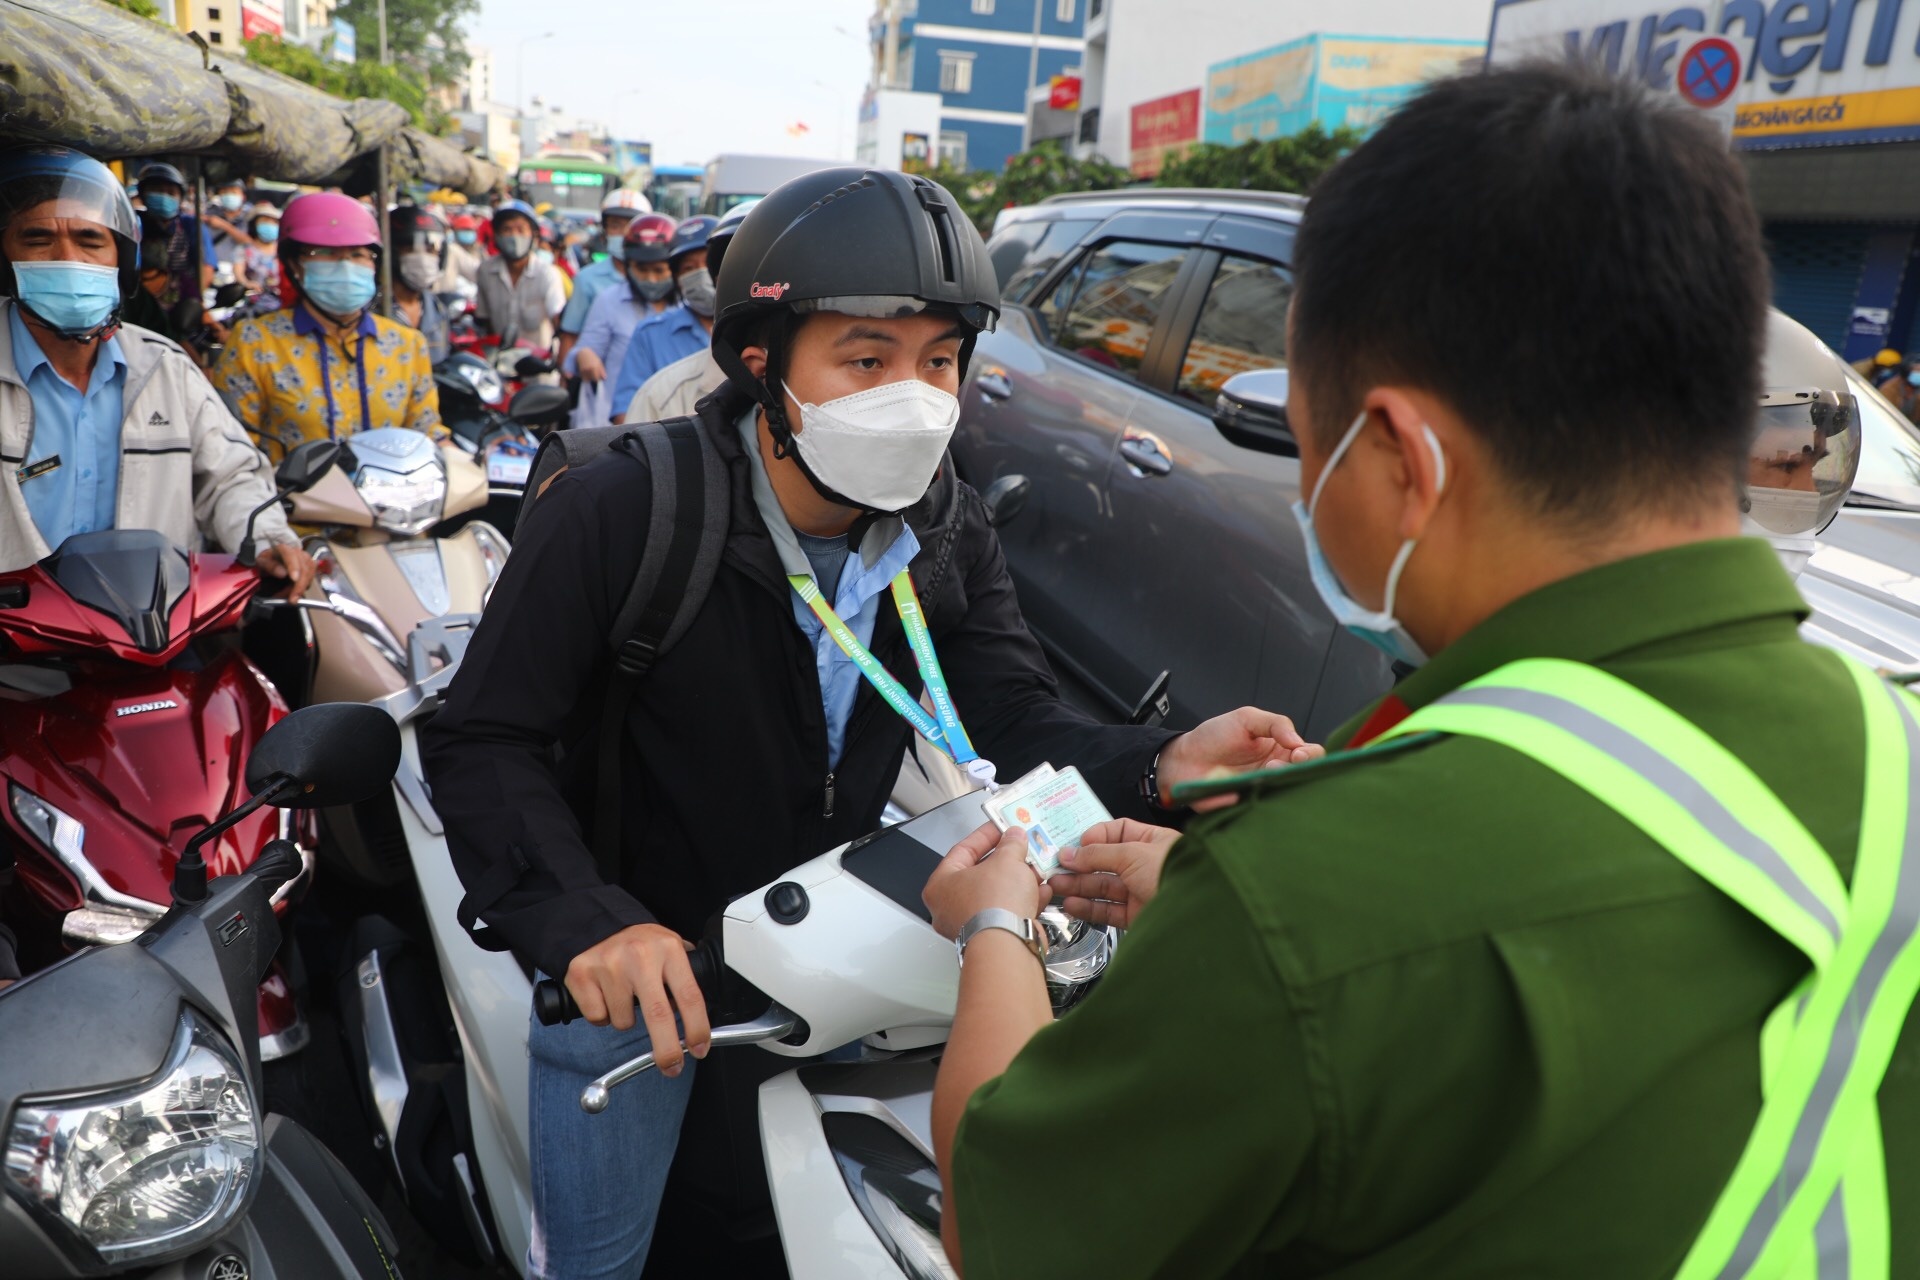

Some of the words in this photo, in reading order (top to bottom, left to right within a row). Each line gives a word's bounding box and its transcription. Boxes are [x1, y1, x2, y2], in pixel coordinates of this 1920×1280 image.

[835, 628, 872, 666] SAMSUNG
[926, 660, 939, 679] FREE
[872, 672, 890, 690] FREE
[116, 700, 178, 717] HONDA
[933, 686, 955, 728] SAMSUNG
